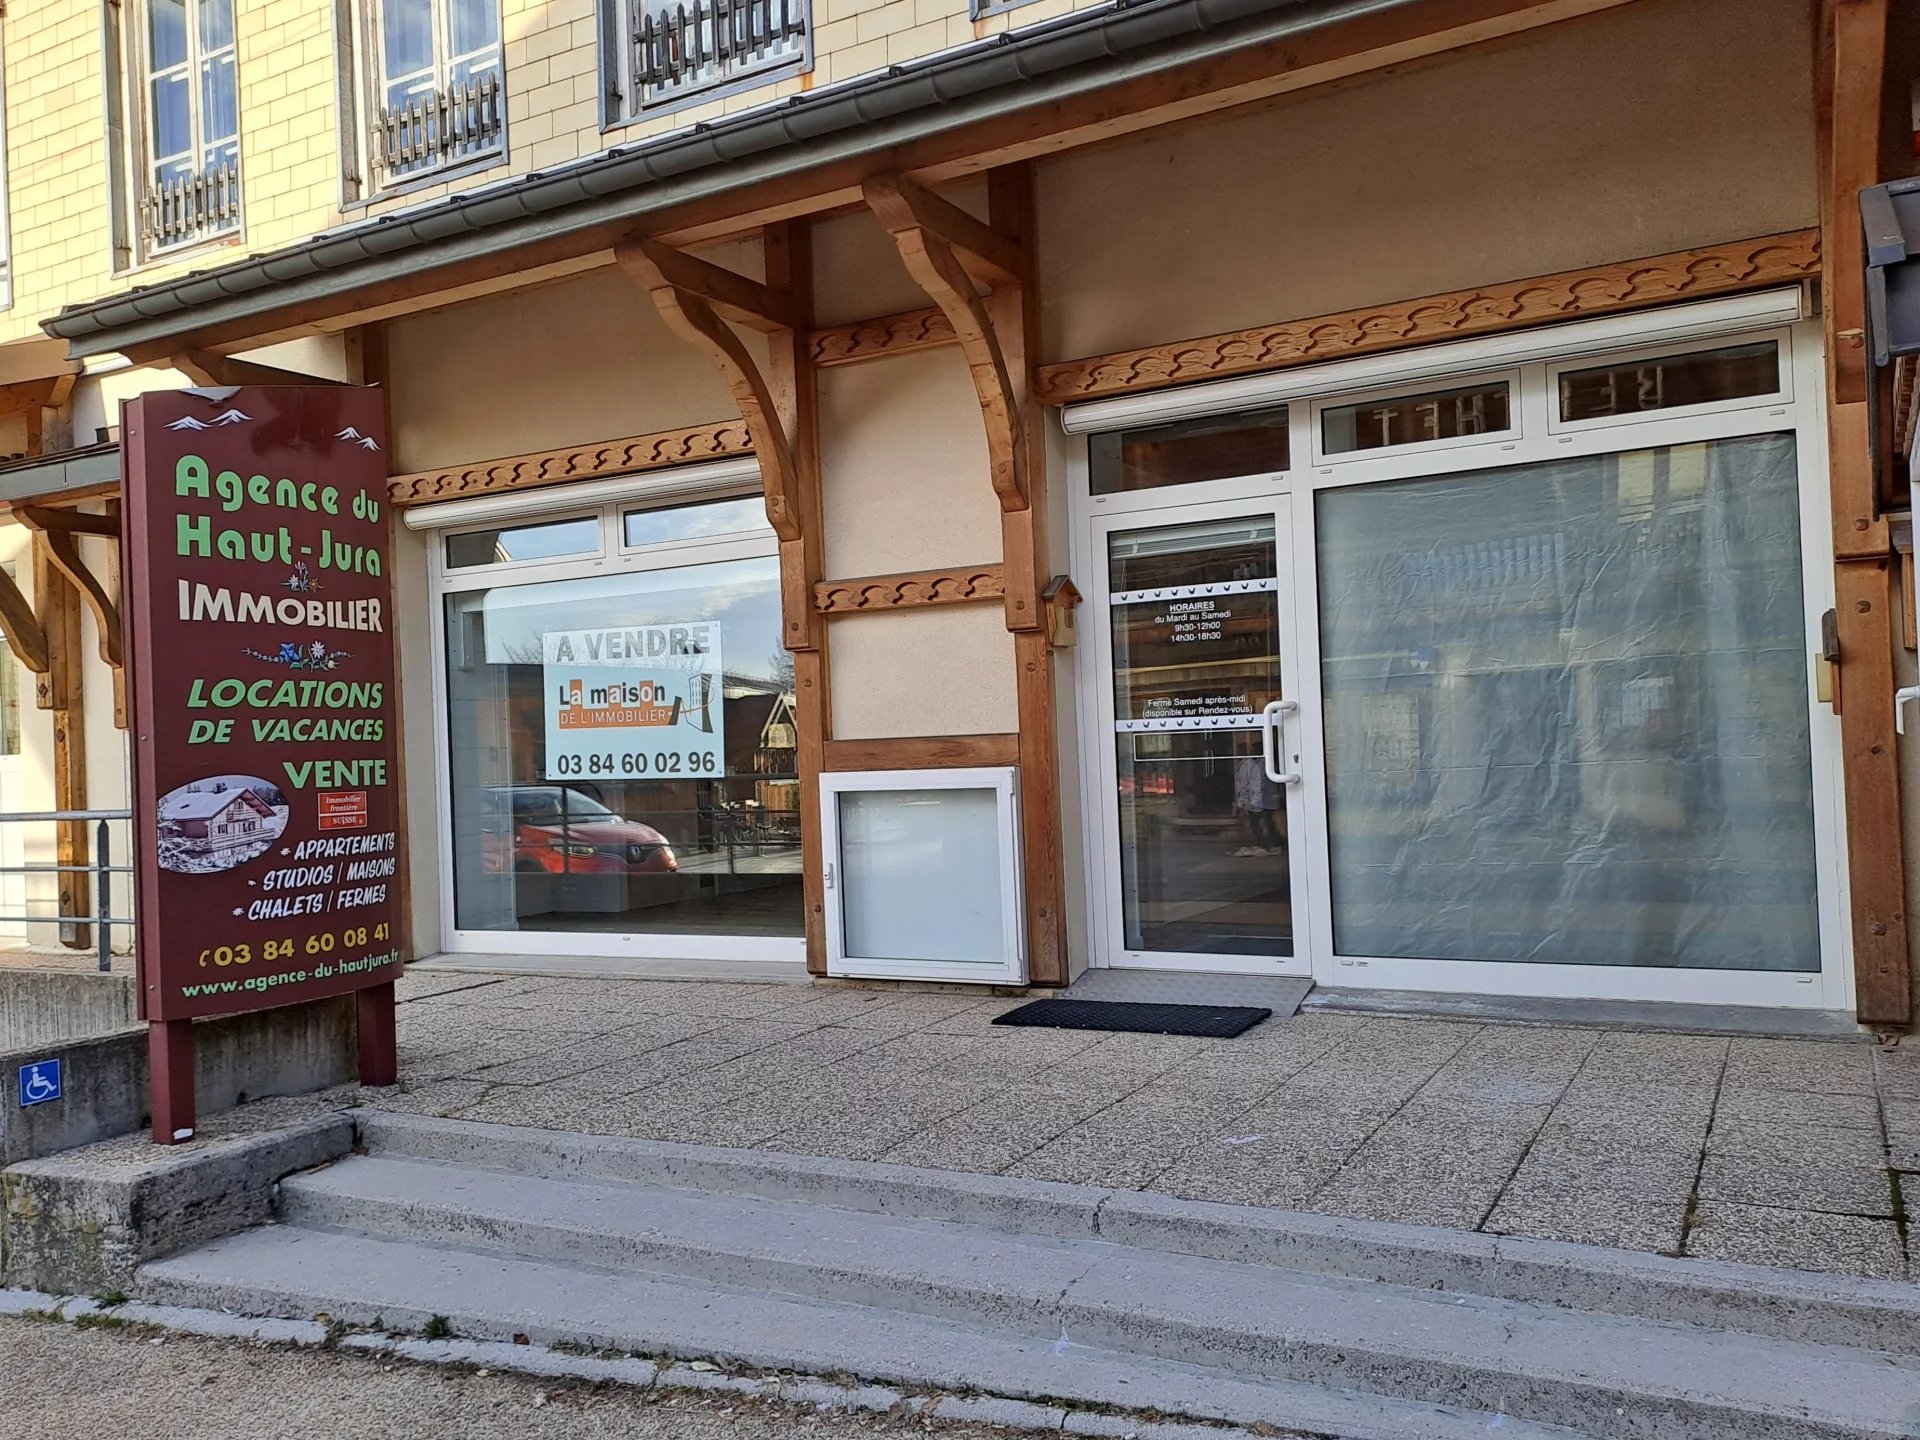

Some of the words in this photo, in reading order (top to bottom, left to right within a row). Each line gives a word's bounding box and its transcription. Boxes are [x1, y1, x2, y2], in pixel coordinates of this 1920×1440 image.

[175, 454, 339, 515] Agence
[352, 488, 380, 524] du
[176, 513, 381, 577] Haut-Jura
[178, 579, 383, 632] IMMOBILIER
[1154, 615, 1165, 624] du
[1166, 613, 1188, 623] Mardi
[1189, 613, 1200, 621] au
[1201, 610, 1231, 620] Samedi
[1169, 601, 1215, 612] HORAIRES
[1171, 631, 1221, 642] 14h30-18h30
[1174, 621, 1221, 632] 9h30-12h00
[556, 637, 575, 663] A
[585, 626, 710, 661] VENDRE
[186, 678, 383, 709] LOCATIONS
[559, 684, 582, 707] La
[590, 682, 665, 705] maison
[1173, 696, 1203, 706] Samedi
[1204, 694, 1246, 706] après-midi
[560, 711, 576, 725] DE
[580, 709, 666, 724] L'IMMOBILIER
[1184, 708, 1197, 716] sur
[1198, 705, 1253, 717] Rendez-vous)
[187, 719, 235, 744] DE
[251, 719, 384, 742] VACANCES
[282, 759, 387, 789] VENTE
[557, 754, 582, 775] 03
[589, 753, 615, 775] 84
[621, 752, 648, 774] 60
[654, 752, 681, 773] 02
[688, 751, 716, 772] 96
[294, 832, 395, 860] APPARTEMENTS
[262, 864, 334, 891] STUDIOS
[347, 857, 395, 881] MAISONS
[247, 893, 323, 921] CHALETS
[336, 884, 386, 910] FERMES
[213, 943, 252, 967] 03
[262, 938, 295, 962] 84
[305, 932, 335, 955] 60
[343, 927, 368, 946] 08
[373, 922, 390, 941] 41
[181, 948, 399, 998] www.agence-du-hautjura.fr
